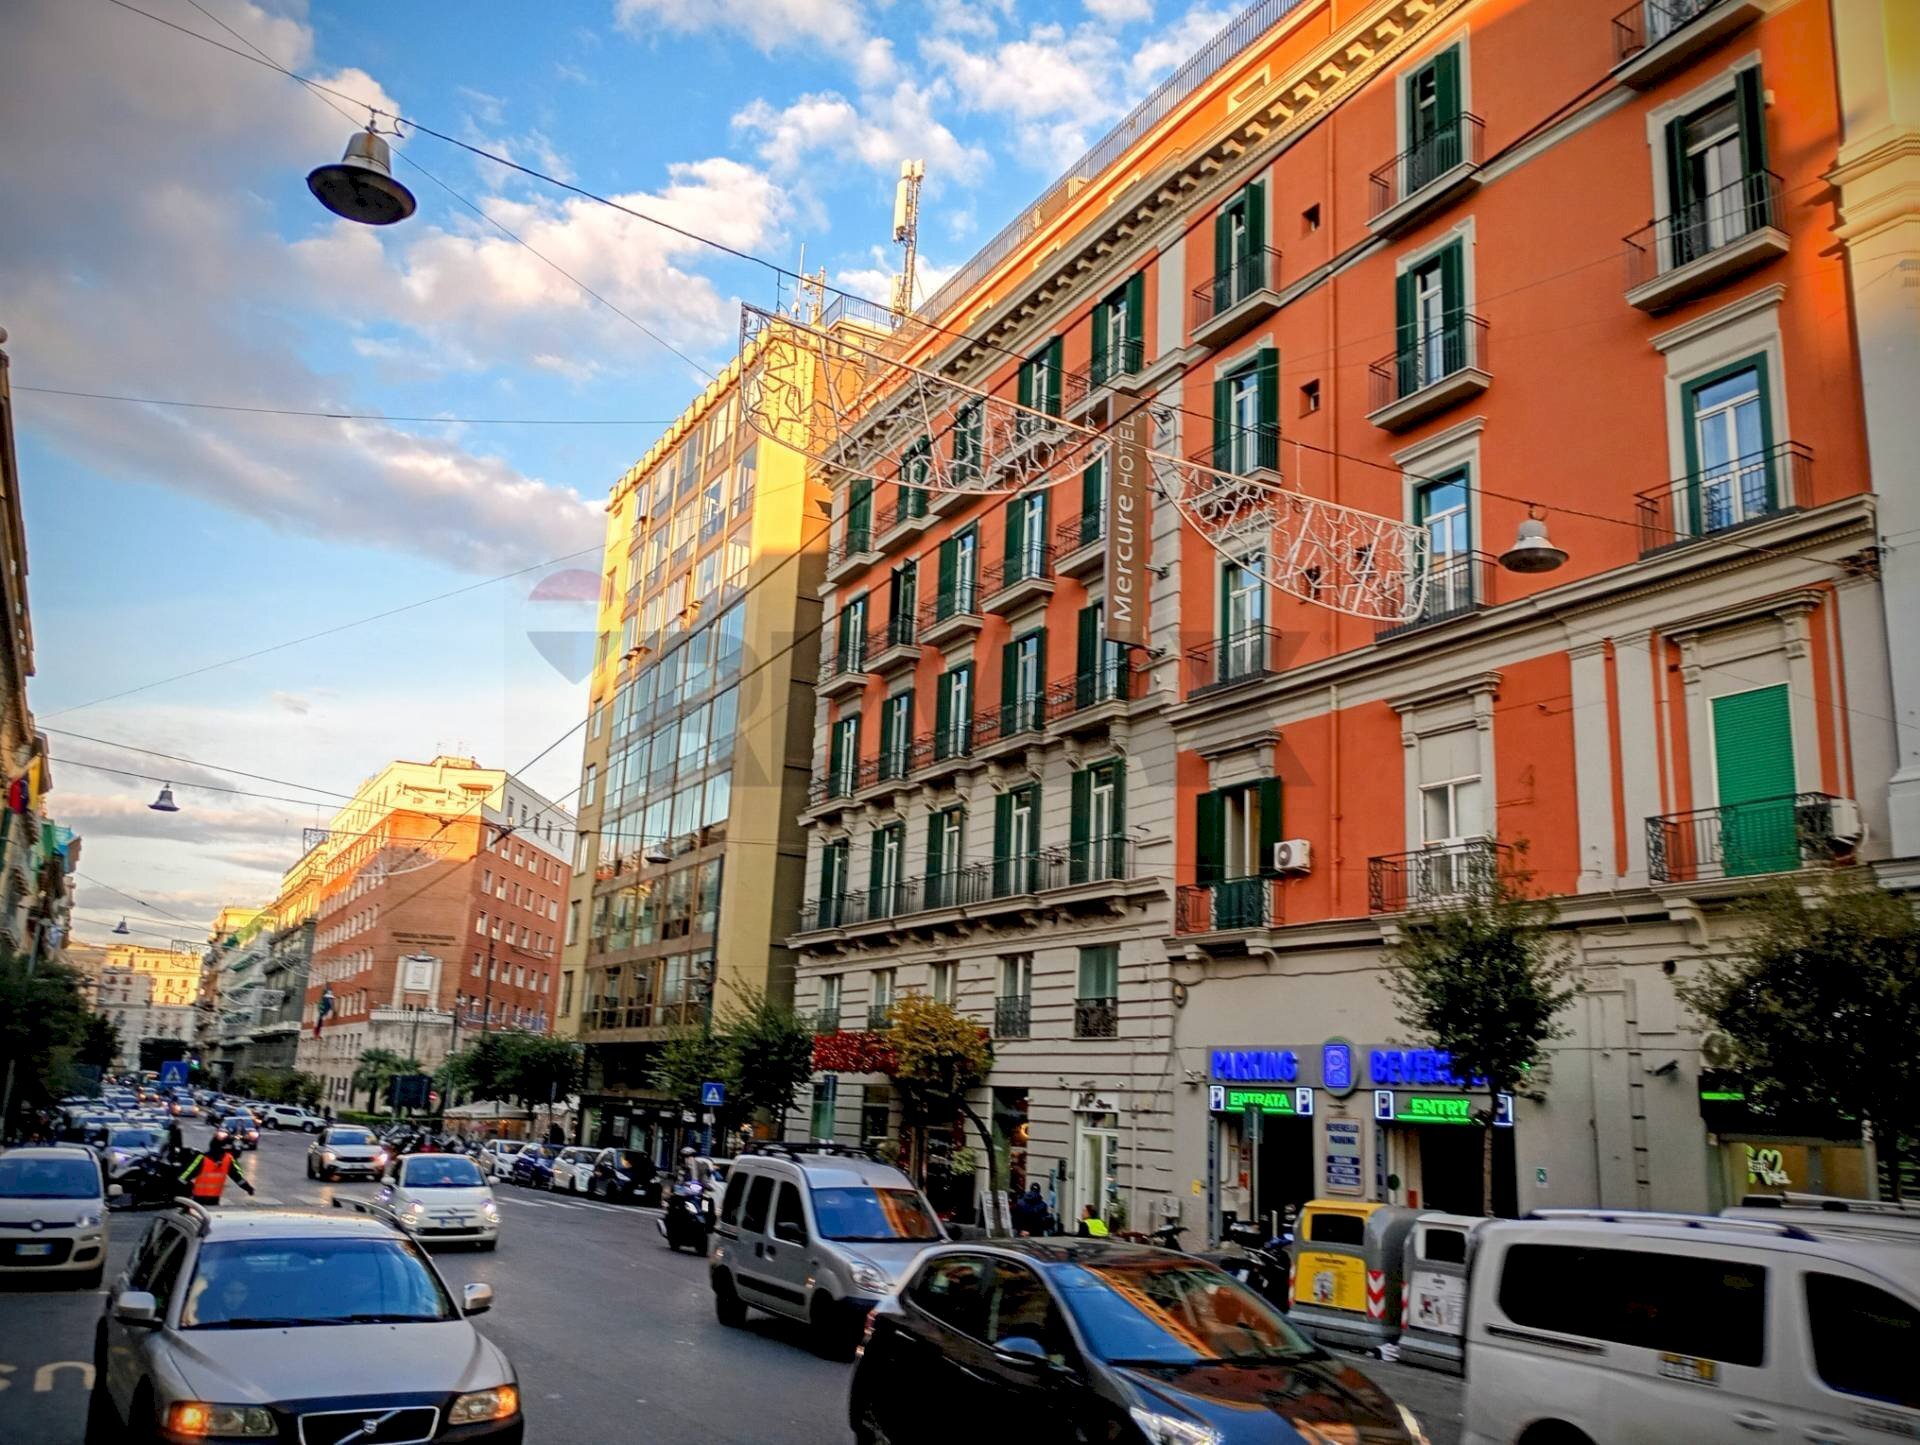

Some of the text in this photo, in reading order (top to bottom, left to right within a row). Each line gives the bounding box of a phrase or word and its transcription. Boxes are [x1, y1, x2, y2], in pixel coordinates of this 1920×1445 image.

[1114, 415, 1136, 622] Mercure HOTEL
[1211, 1050, 1297, 1082] PARKING
[1229, 1091, 1290, 1108] ENTRATA
[1411, 1098, 1470, 1116] ENTRY
